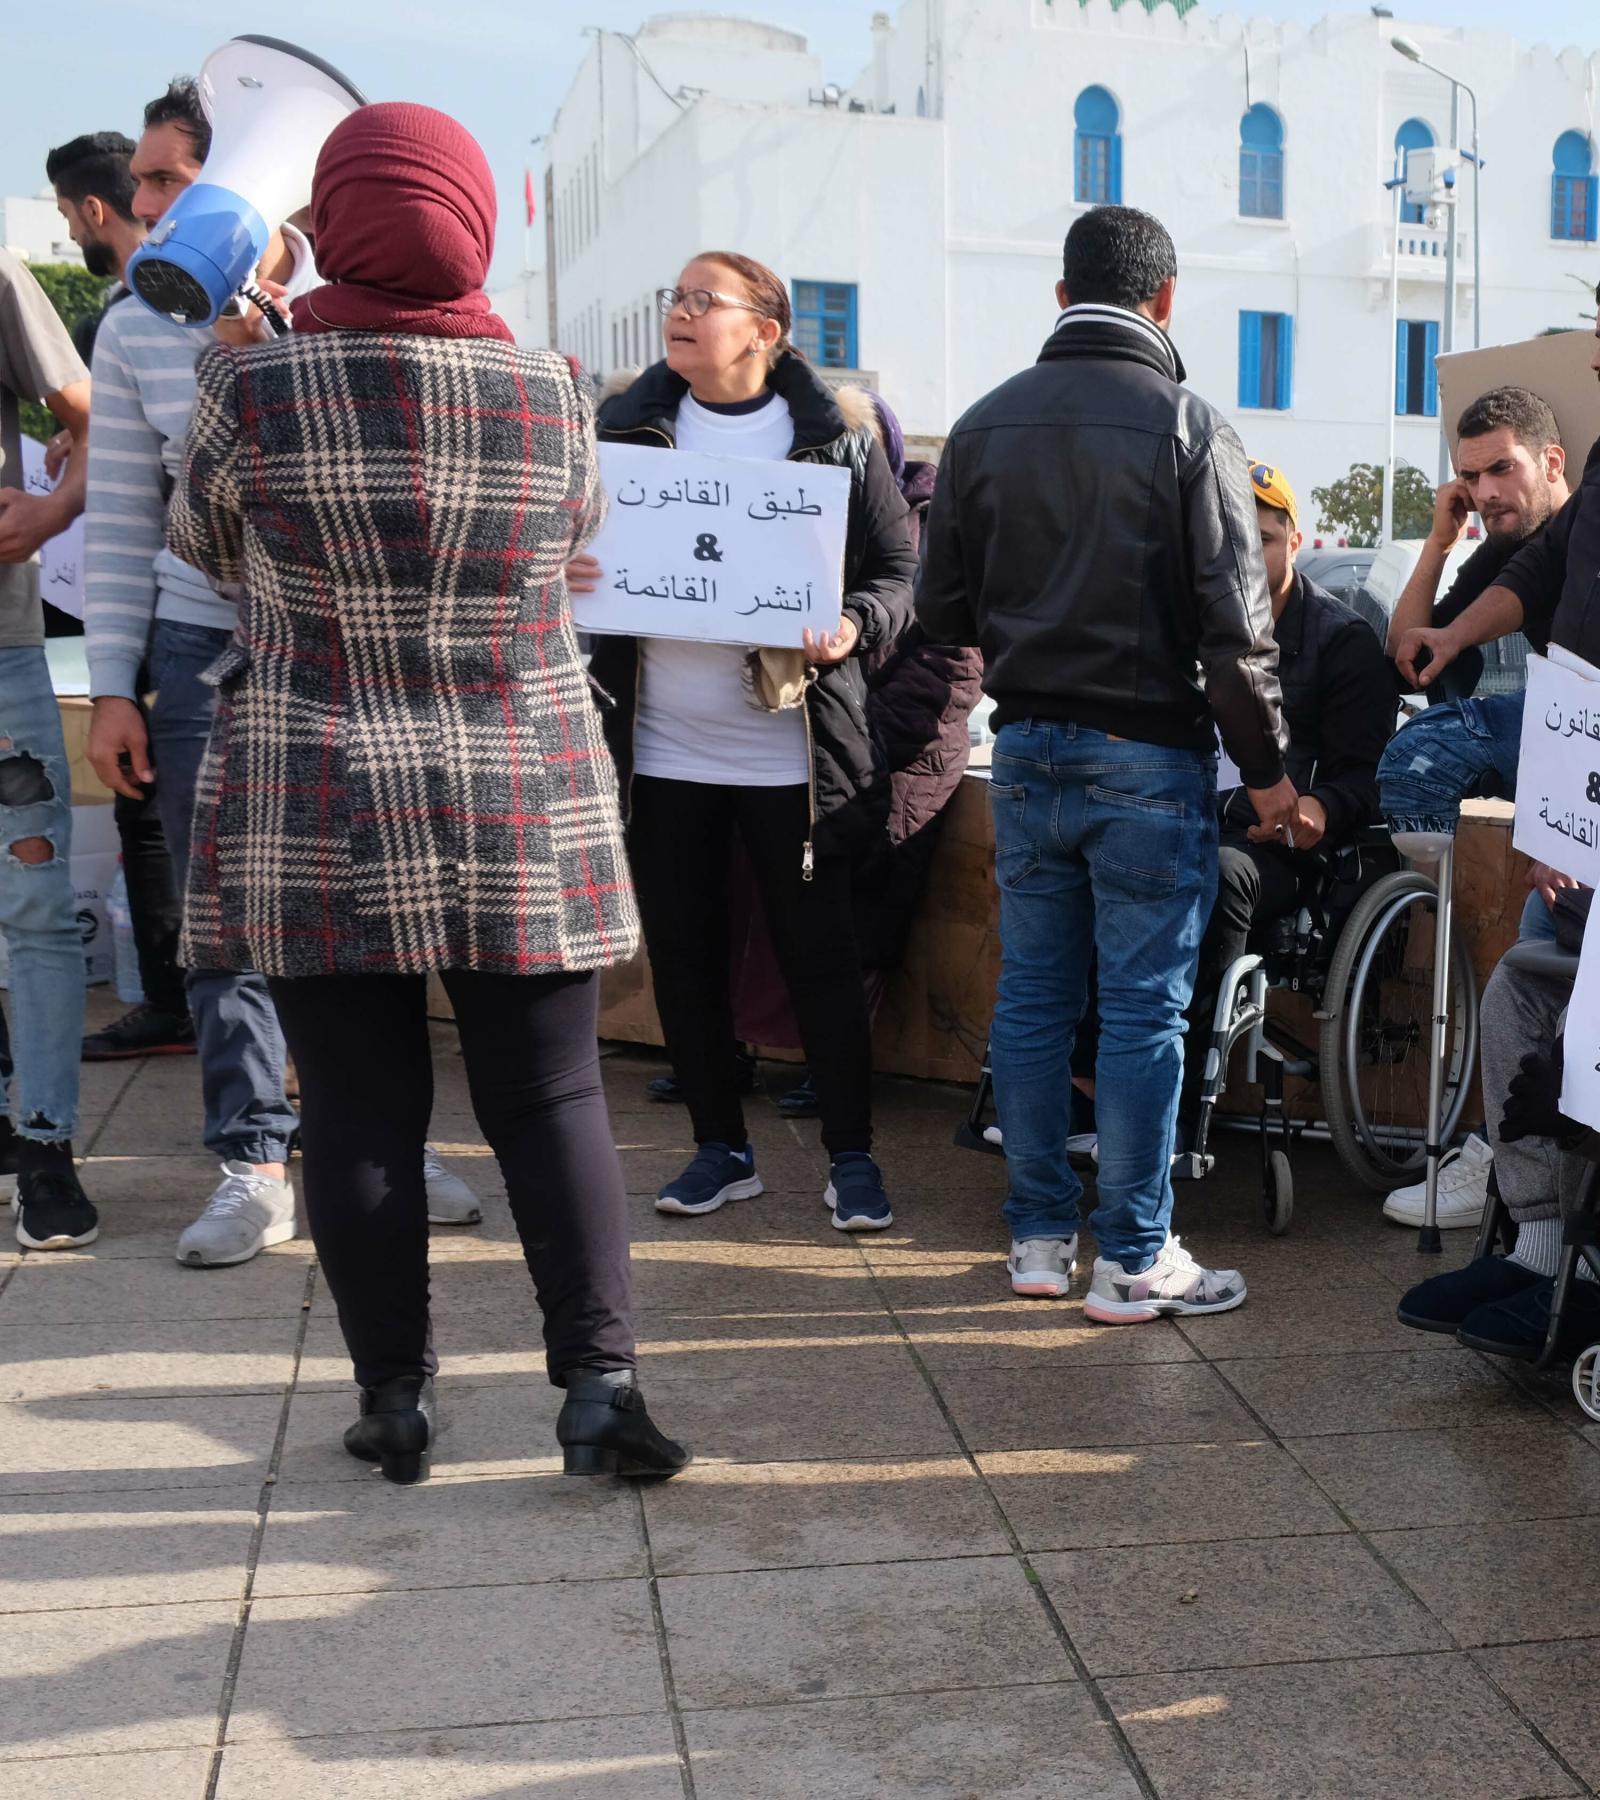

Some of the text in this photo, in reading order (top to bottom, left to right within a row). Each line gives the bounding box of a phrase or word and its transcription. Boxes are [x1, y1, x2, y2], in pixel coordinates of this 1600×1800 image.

[617, 479, 821, 520] طبق القانون
[693, 533, 723, 562] &
[613, 568, 813, 615] أنشر القائمة
[1539, 797, 1599, 850] القائمة
